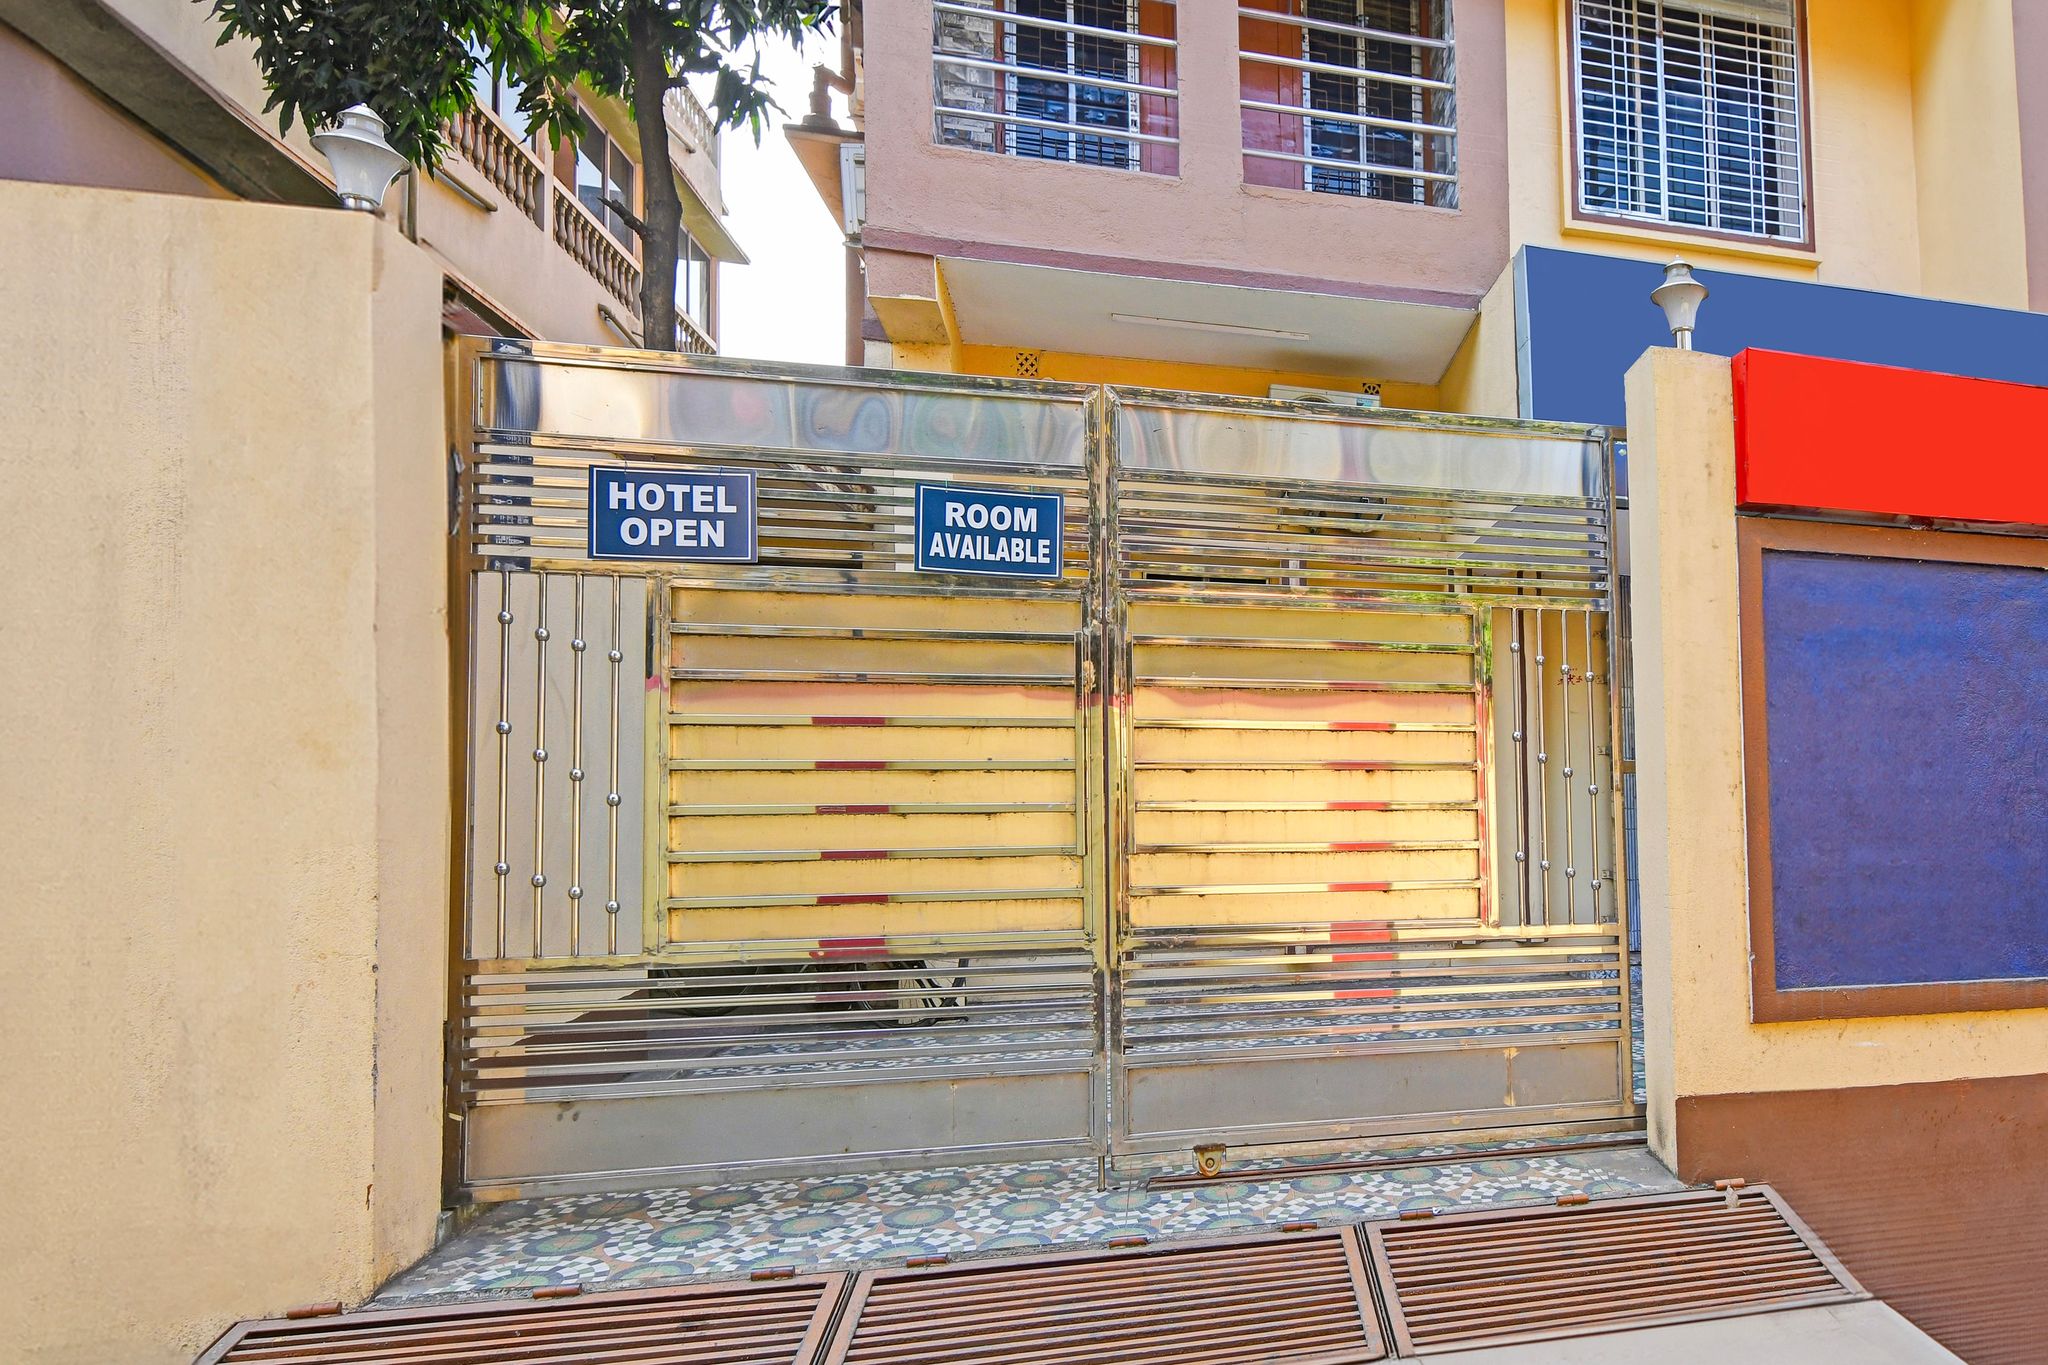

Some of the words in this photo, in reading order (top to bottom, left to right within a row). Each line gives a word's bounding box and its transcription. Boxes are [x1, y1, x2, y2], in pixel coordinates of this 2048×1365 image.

[609, 481, 737, 513] HOTEL
[620, 517, 725, 548] OPEN
[945, 501, 1037, 533] ROOM
[929, 532, 1050, 564] AVAILABLE
